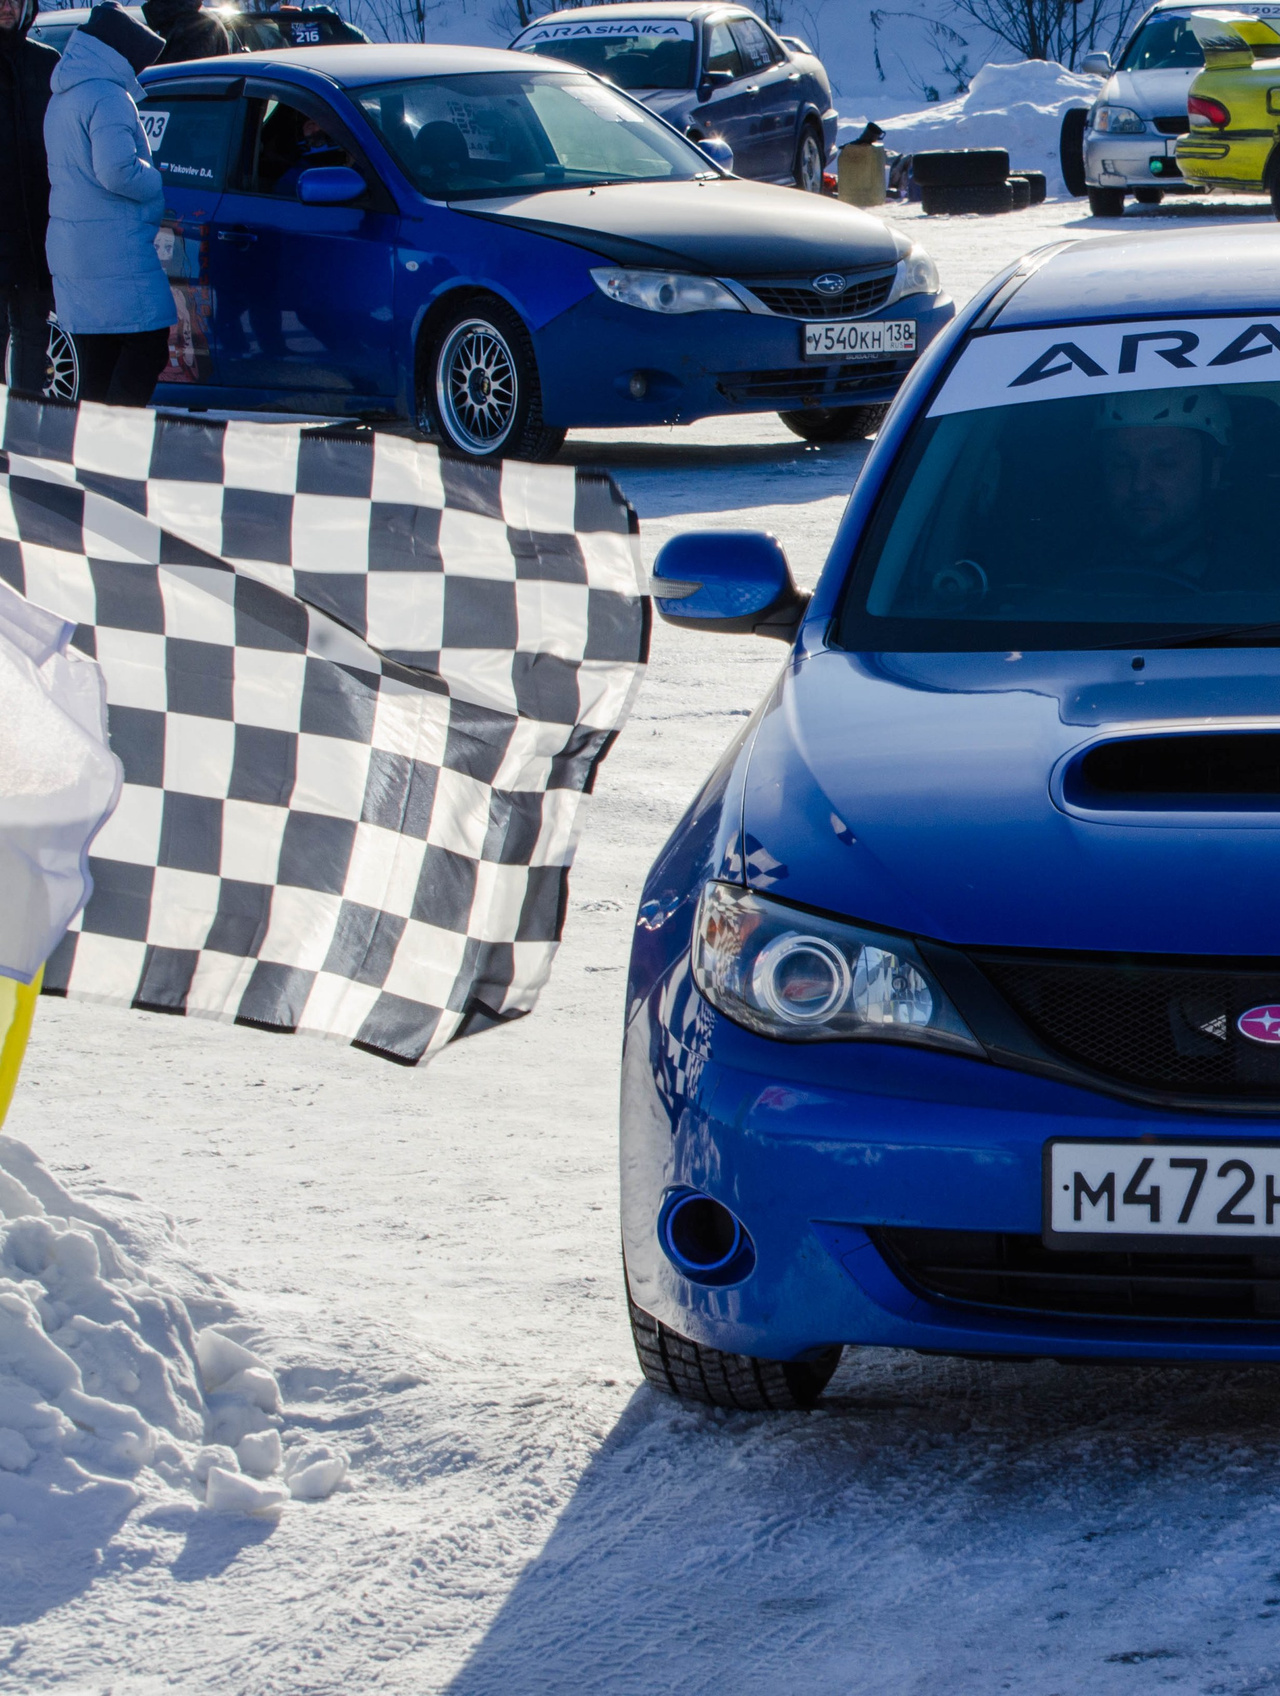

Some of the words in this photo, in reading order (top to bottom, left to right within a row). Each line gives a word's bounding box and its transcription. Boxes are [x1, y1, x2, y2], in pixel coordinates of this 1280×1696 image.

[296, 31, 320, 43] 216
[530, 25, 680, 41] ARASHAIKA
[886, 323, 911, 341] 138
